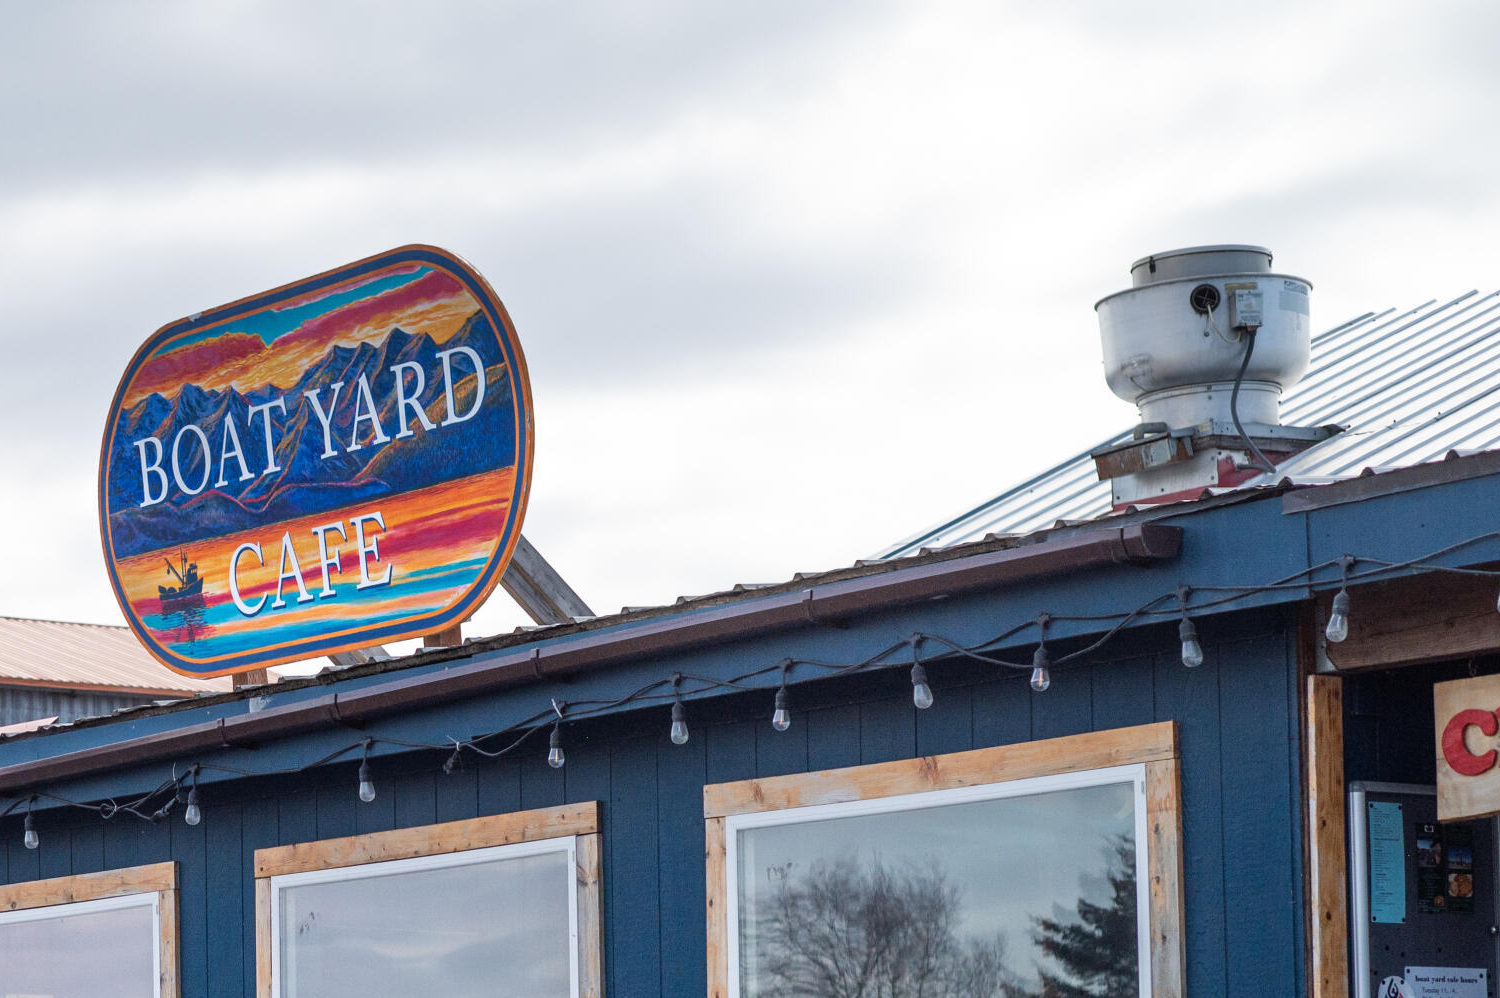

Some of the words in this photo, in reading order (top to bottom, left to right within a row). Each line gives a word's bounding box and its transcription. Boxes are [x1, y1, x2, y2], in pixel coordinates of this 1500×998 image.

[134, 400, 288, 508] BOAT
[304, 346, 487, 460] YARD
[229, 511, 393, 618] CAFE
[1431, 976, 1446, 985] yard
